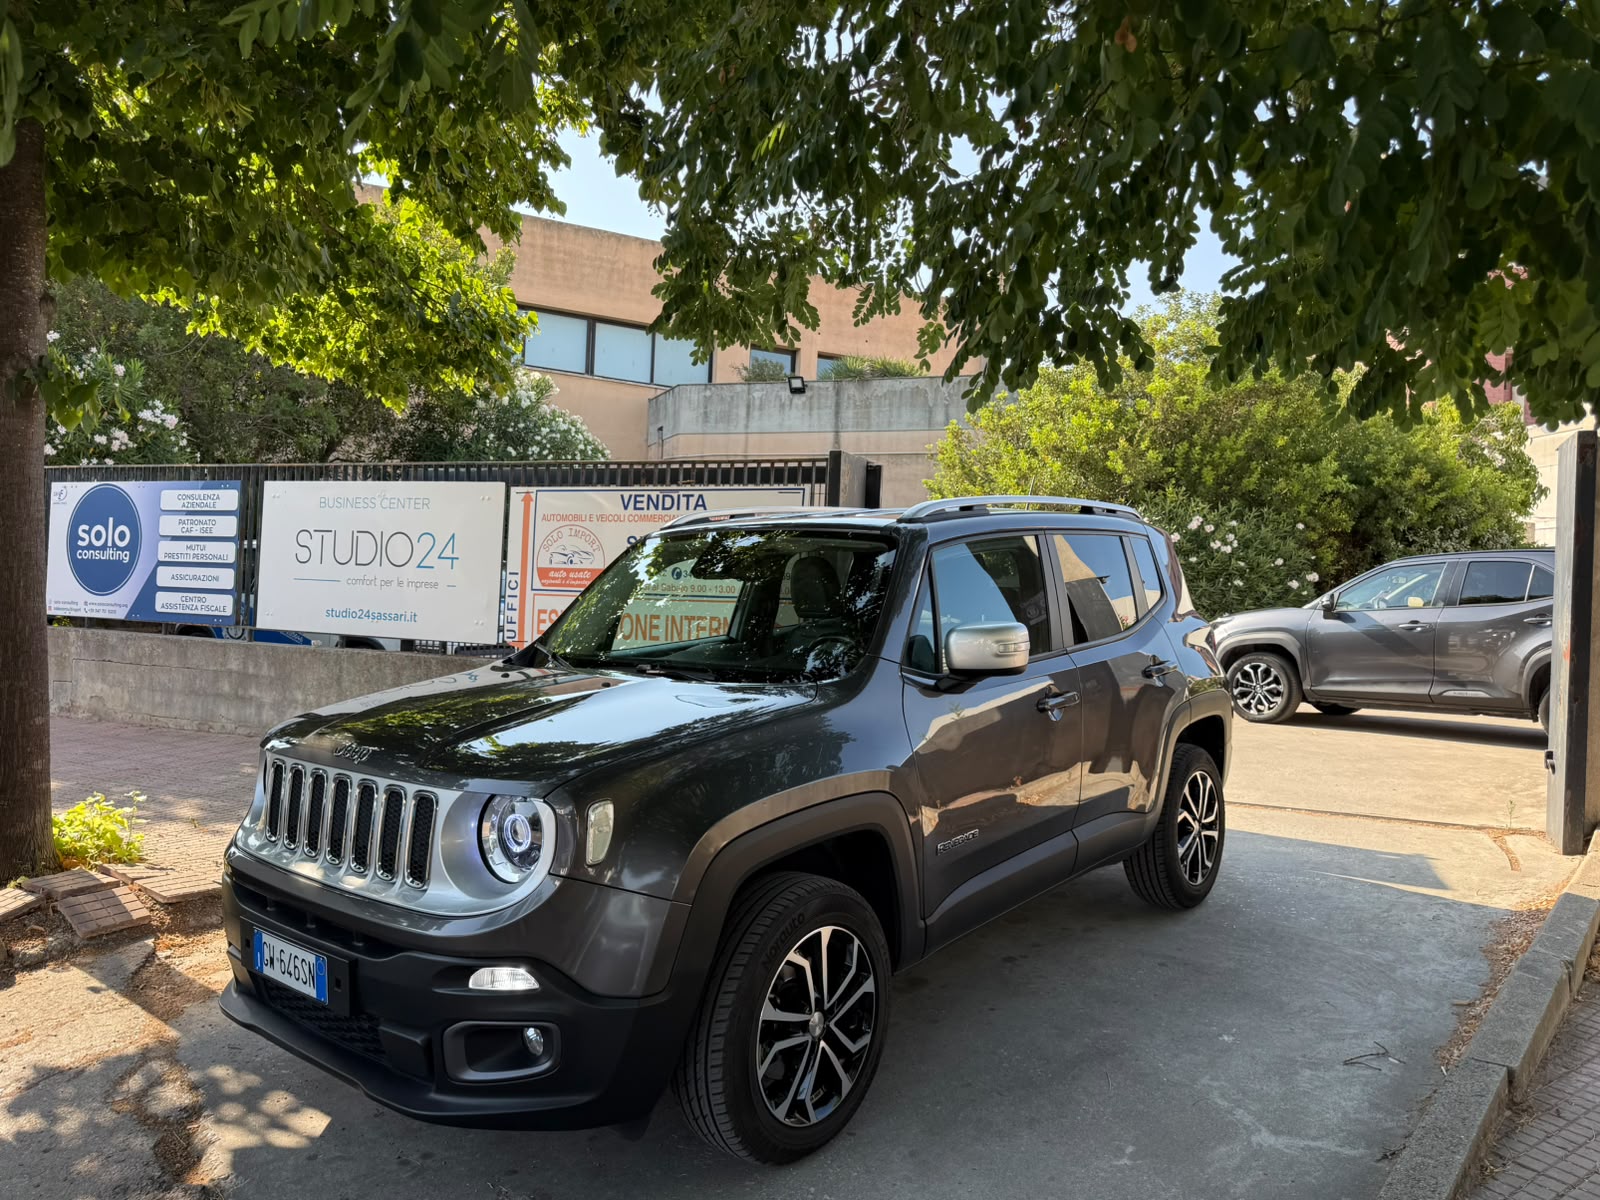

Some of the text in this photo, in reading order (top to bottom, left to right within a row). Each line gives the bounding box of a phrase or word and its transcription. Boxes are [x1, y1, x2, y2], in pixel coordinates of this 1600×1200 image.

[176, 493, 221, 501] CONSULENZA
[620, 493, 708, 511] VENDITA
[181, 501, 217, 509] AZIENDALE
[319, 496, 431, 510] BUSINESS CENTER
[178, 518, 217, 526] PATRONATO
[541, 513, 587, 522] AUTOMOBILI
[588, 514, 594, 522] E
[595, 514, 626, 523] VEICOLI
[77, 516, 131, 548] solo
[180, 526, 194, 534] CAF
[543, 530, 564, 552] SOLO
[568, 527, 601, 552] IMPORT
[295, 529, 460, 570] STUDIO24
[76, 547, 130, 563] consulting
[163, 552, 229, 561] PRESTITI PERSONALI
[170, 573, 220, 582] ASSICURAZIONI
[549, 570, 592, 579] auto usate
[346, 575, 439, 592] comfort per le imprese
[690, 584, 708, 592] 9.00
[714, 585, 736, 594] 13.00
[180, 595, 207, 604] CENTRO
[160, 602, 228, 613] ASSISTENZA FISCALE
[506, 571, 519, 639] UFFICI
[325, 608, 418, 623] studio24sassari.it
